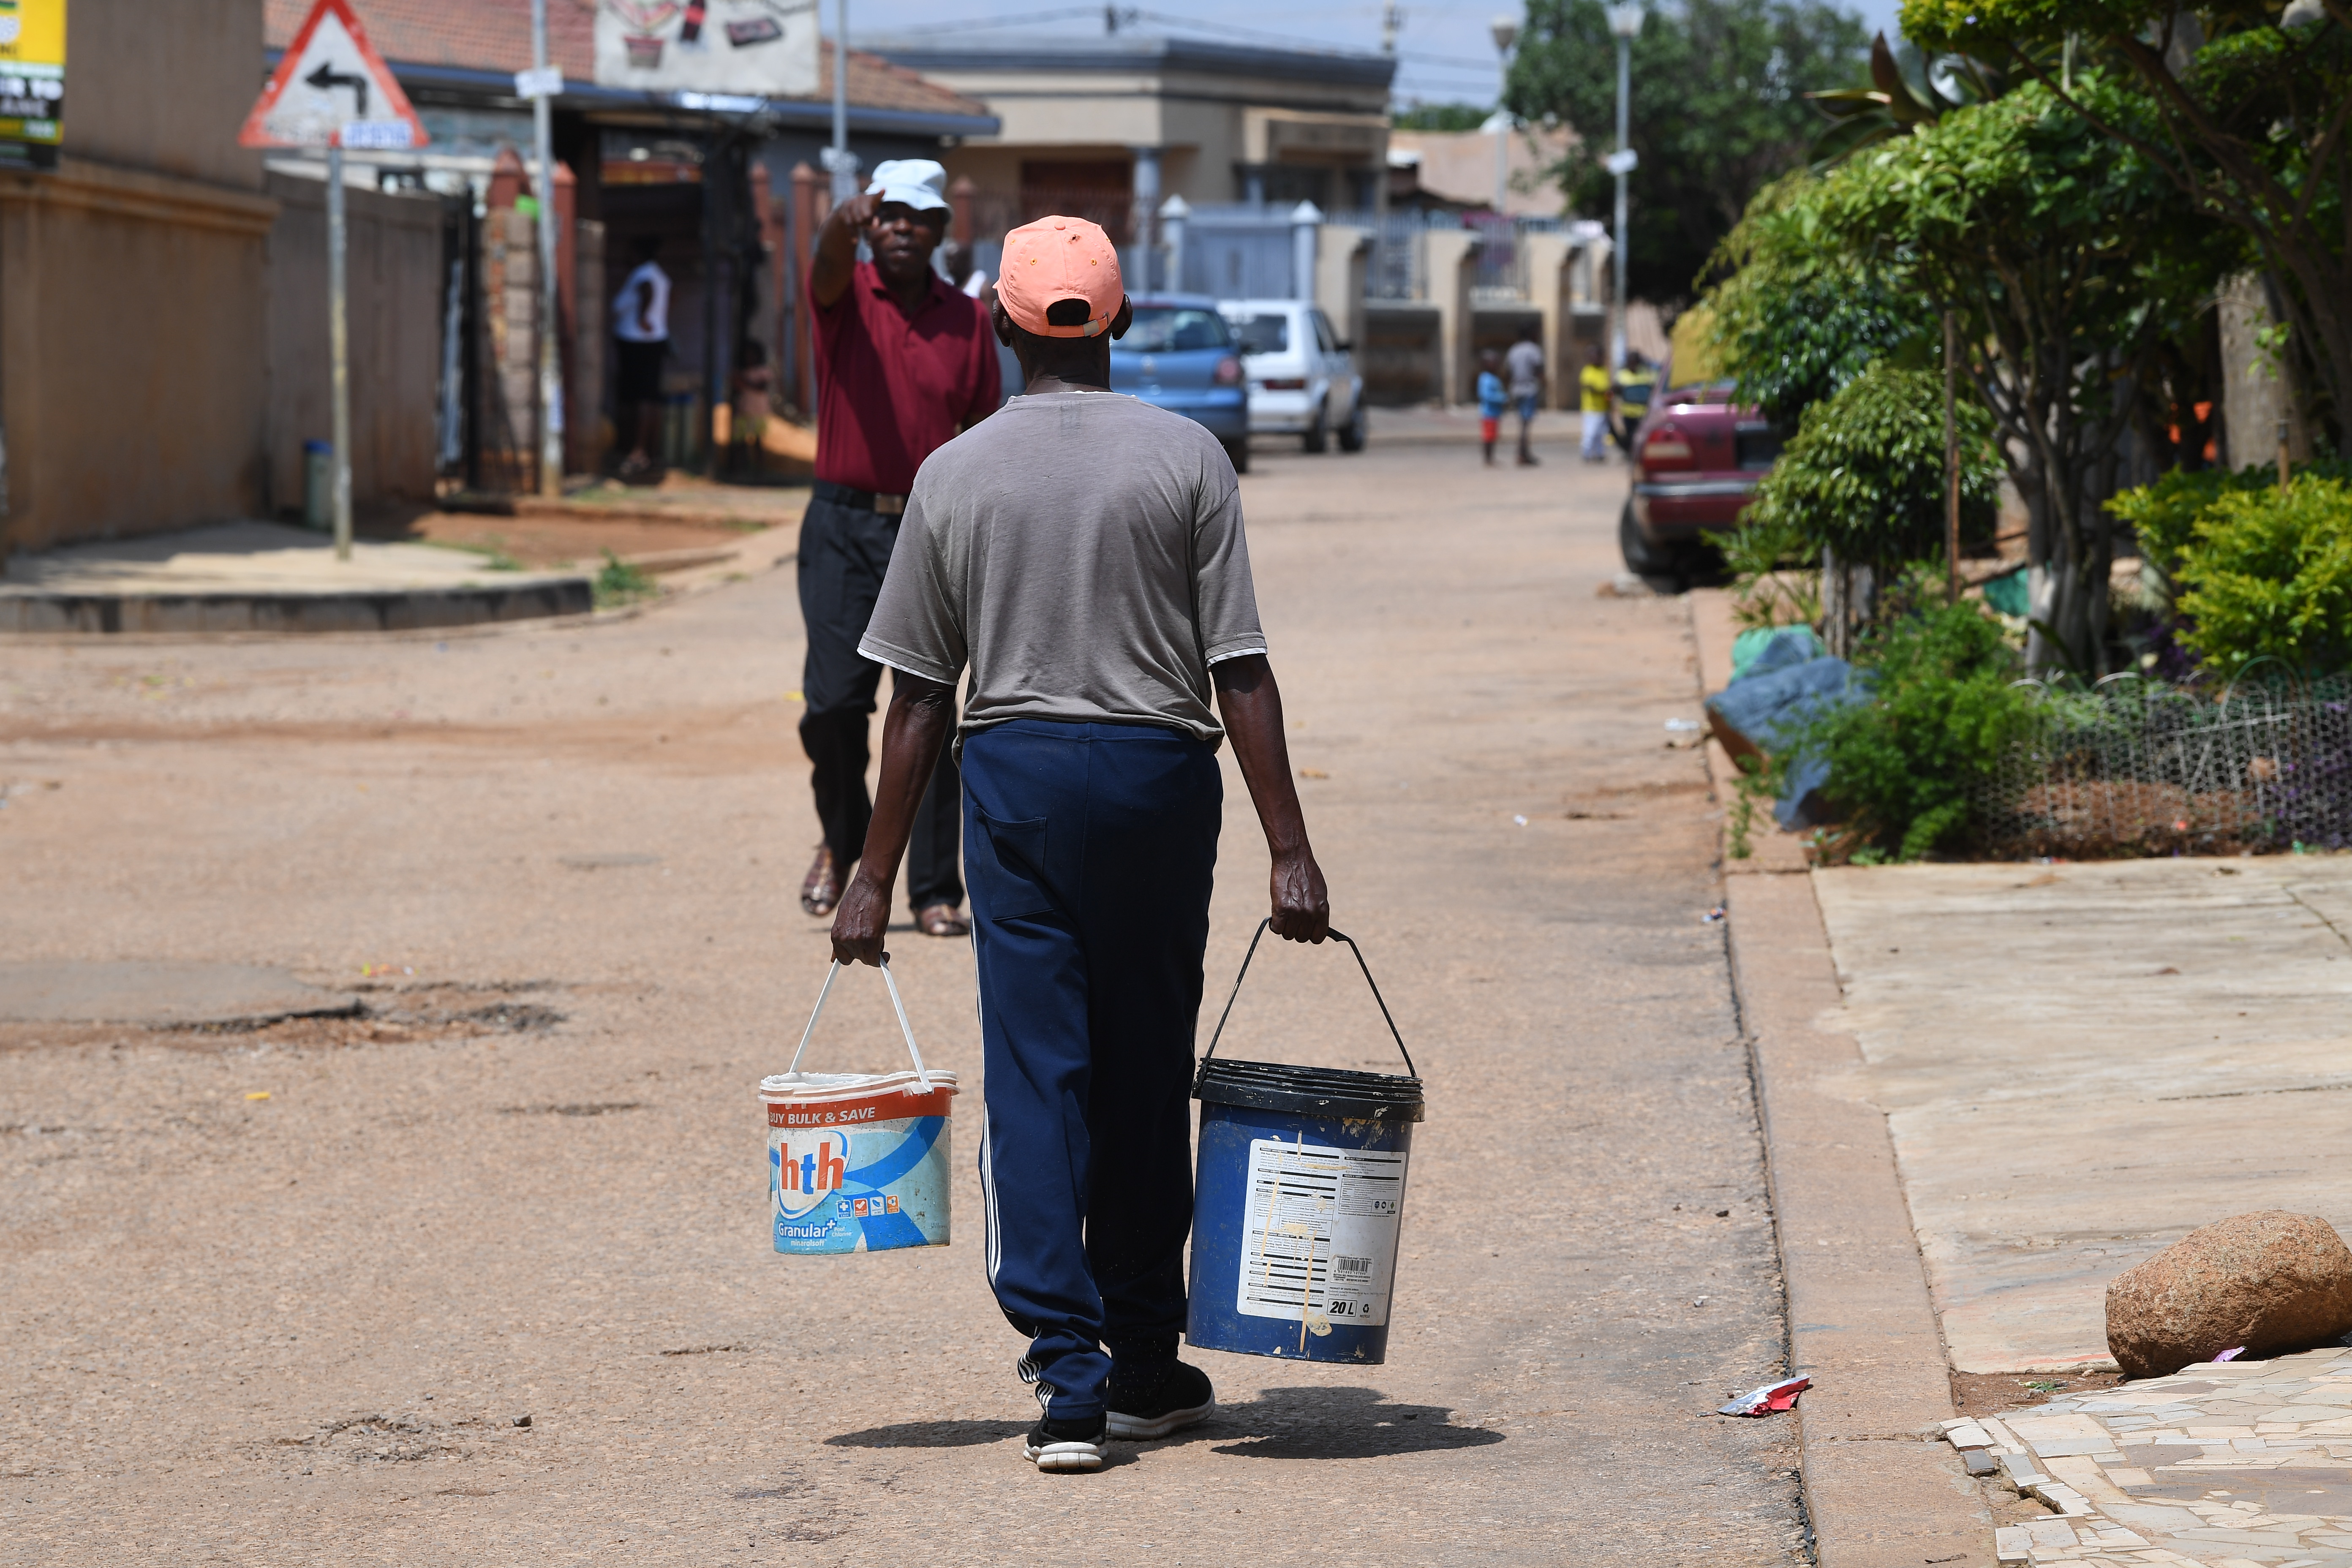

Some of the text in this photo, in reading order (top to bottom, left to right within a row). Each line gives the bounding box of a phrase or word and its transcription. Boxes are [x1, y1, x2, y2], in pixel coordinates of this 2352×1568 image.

[770, 1112, 785, 1124] BUY
[788, 1113, 821, 1124] BULK
[825, 1112, 836, 1123] &
[839, 1107, 876, 1122] SAVE
[781, 1142, 844, 1195] hth
[1329, 1300, 1354, 1315] 20 L
